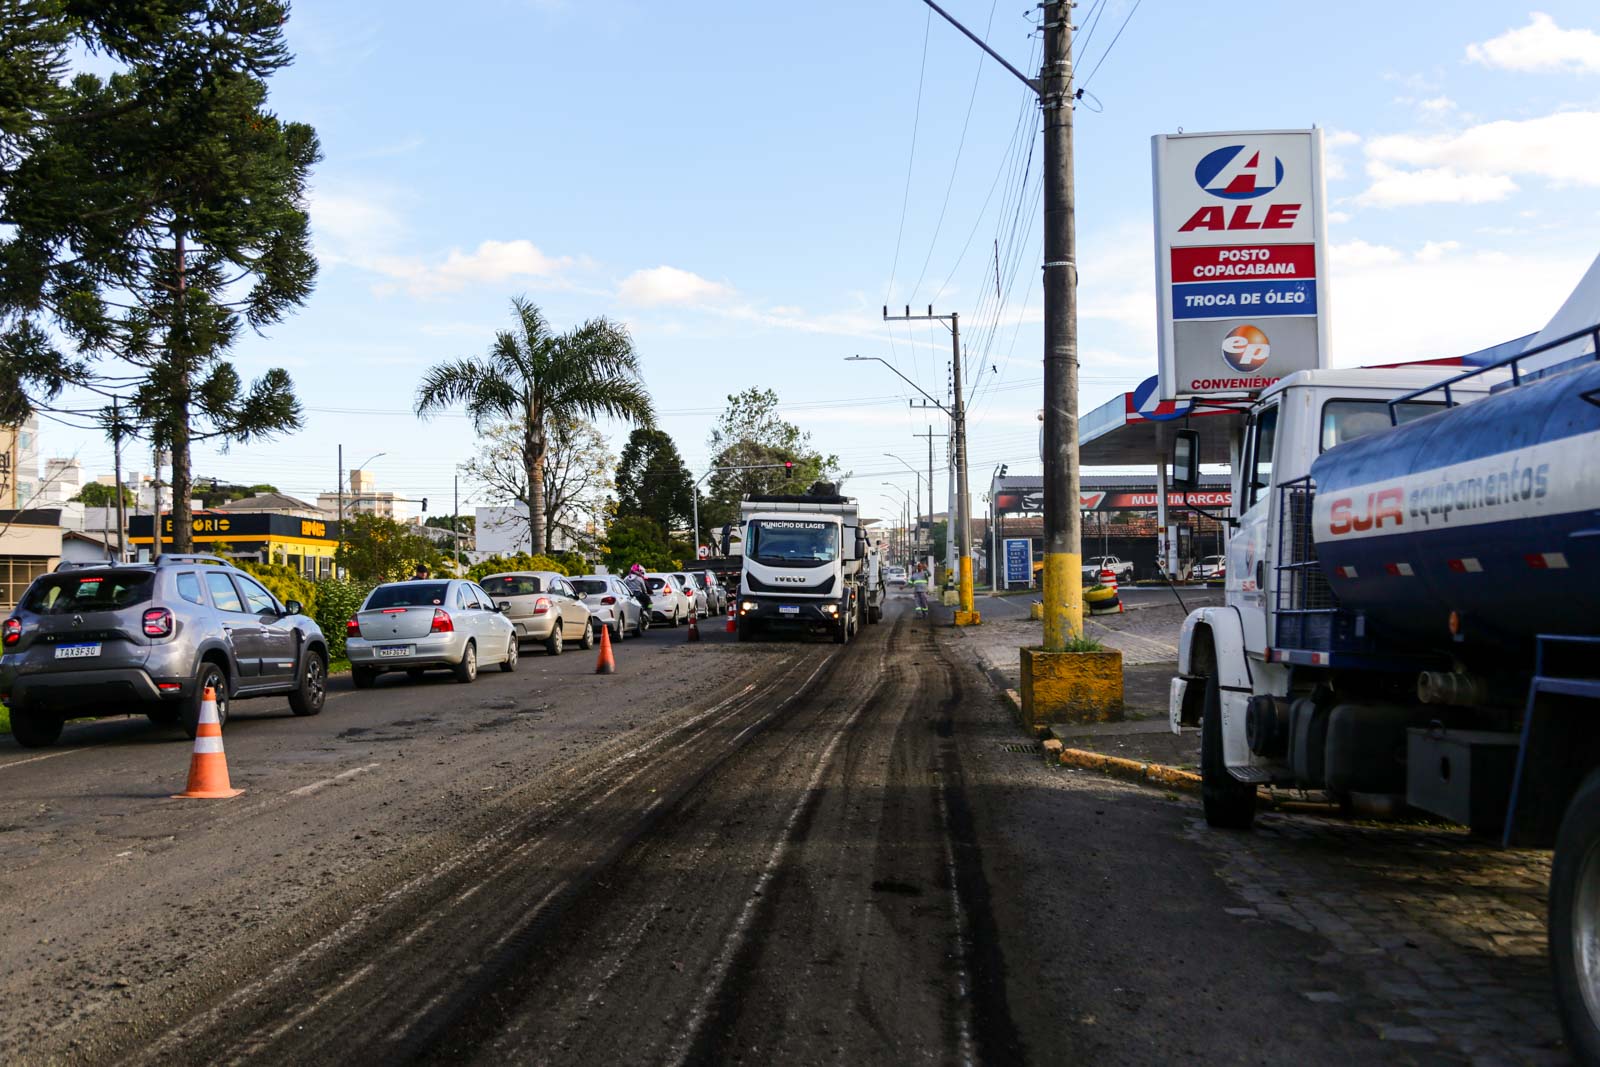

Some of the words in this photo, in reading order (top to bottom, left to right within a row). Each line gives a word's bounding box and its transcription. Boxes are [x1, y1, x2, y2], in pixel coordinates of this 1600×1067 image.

[1177, 203, 1302, 232] ALE
[1218, 248, 1270, 262] POSTO
[1193, 262, 1296, 277] COPACABANA
[1184, 293, 1235, 307] TROCA
[1239, 292, 1261, 305] DE
[1265, 289, 1305, 304] ÓLEO
[1131, 493, 1232, 505] MUIMARCAS
[1330, 486, 1404, 536] SJR
[166, 518, 231, 532] EÓRIO
[760, 521, 794, 529] MUNICÍPIO
[805, 522, 825, 530] LAGES
[775, 575, 806, 583] IVECO
